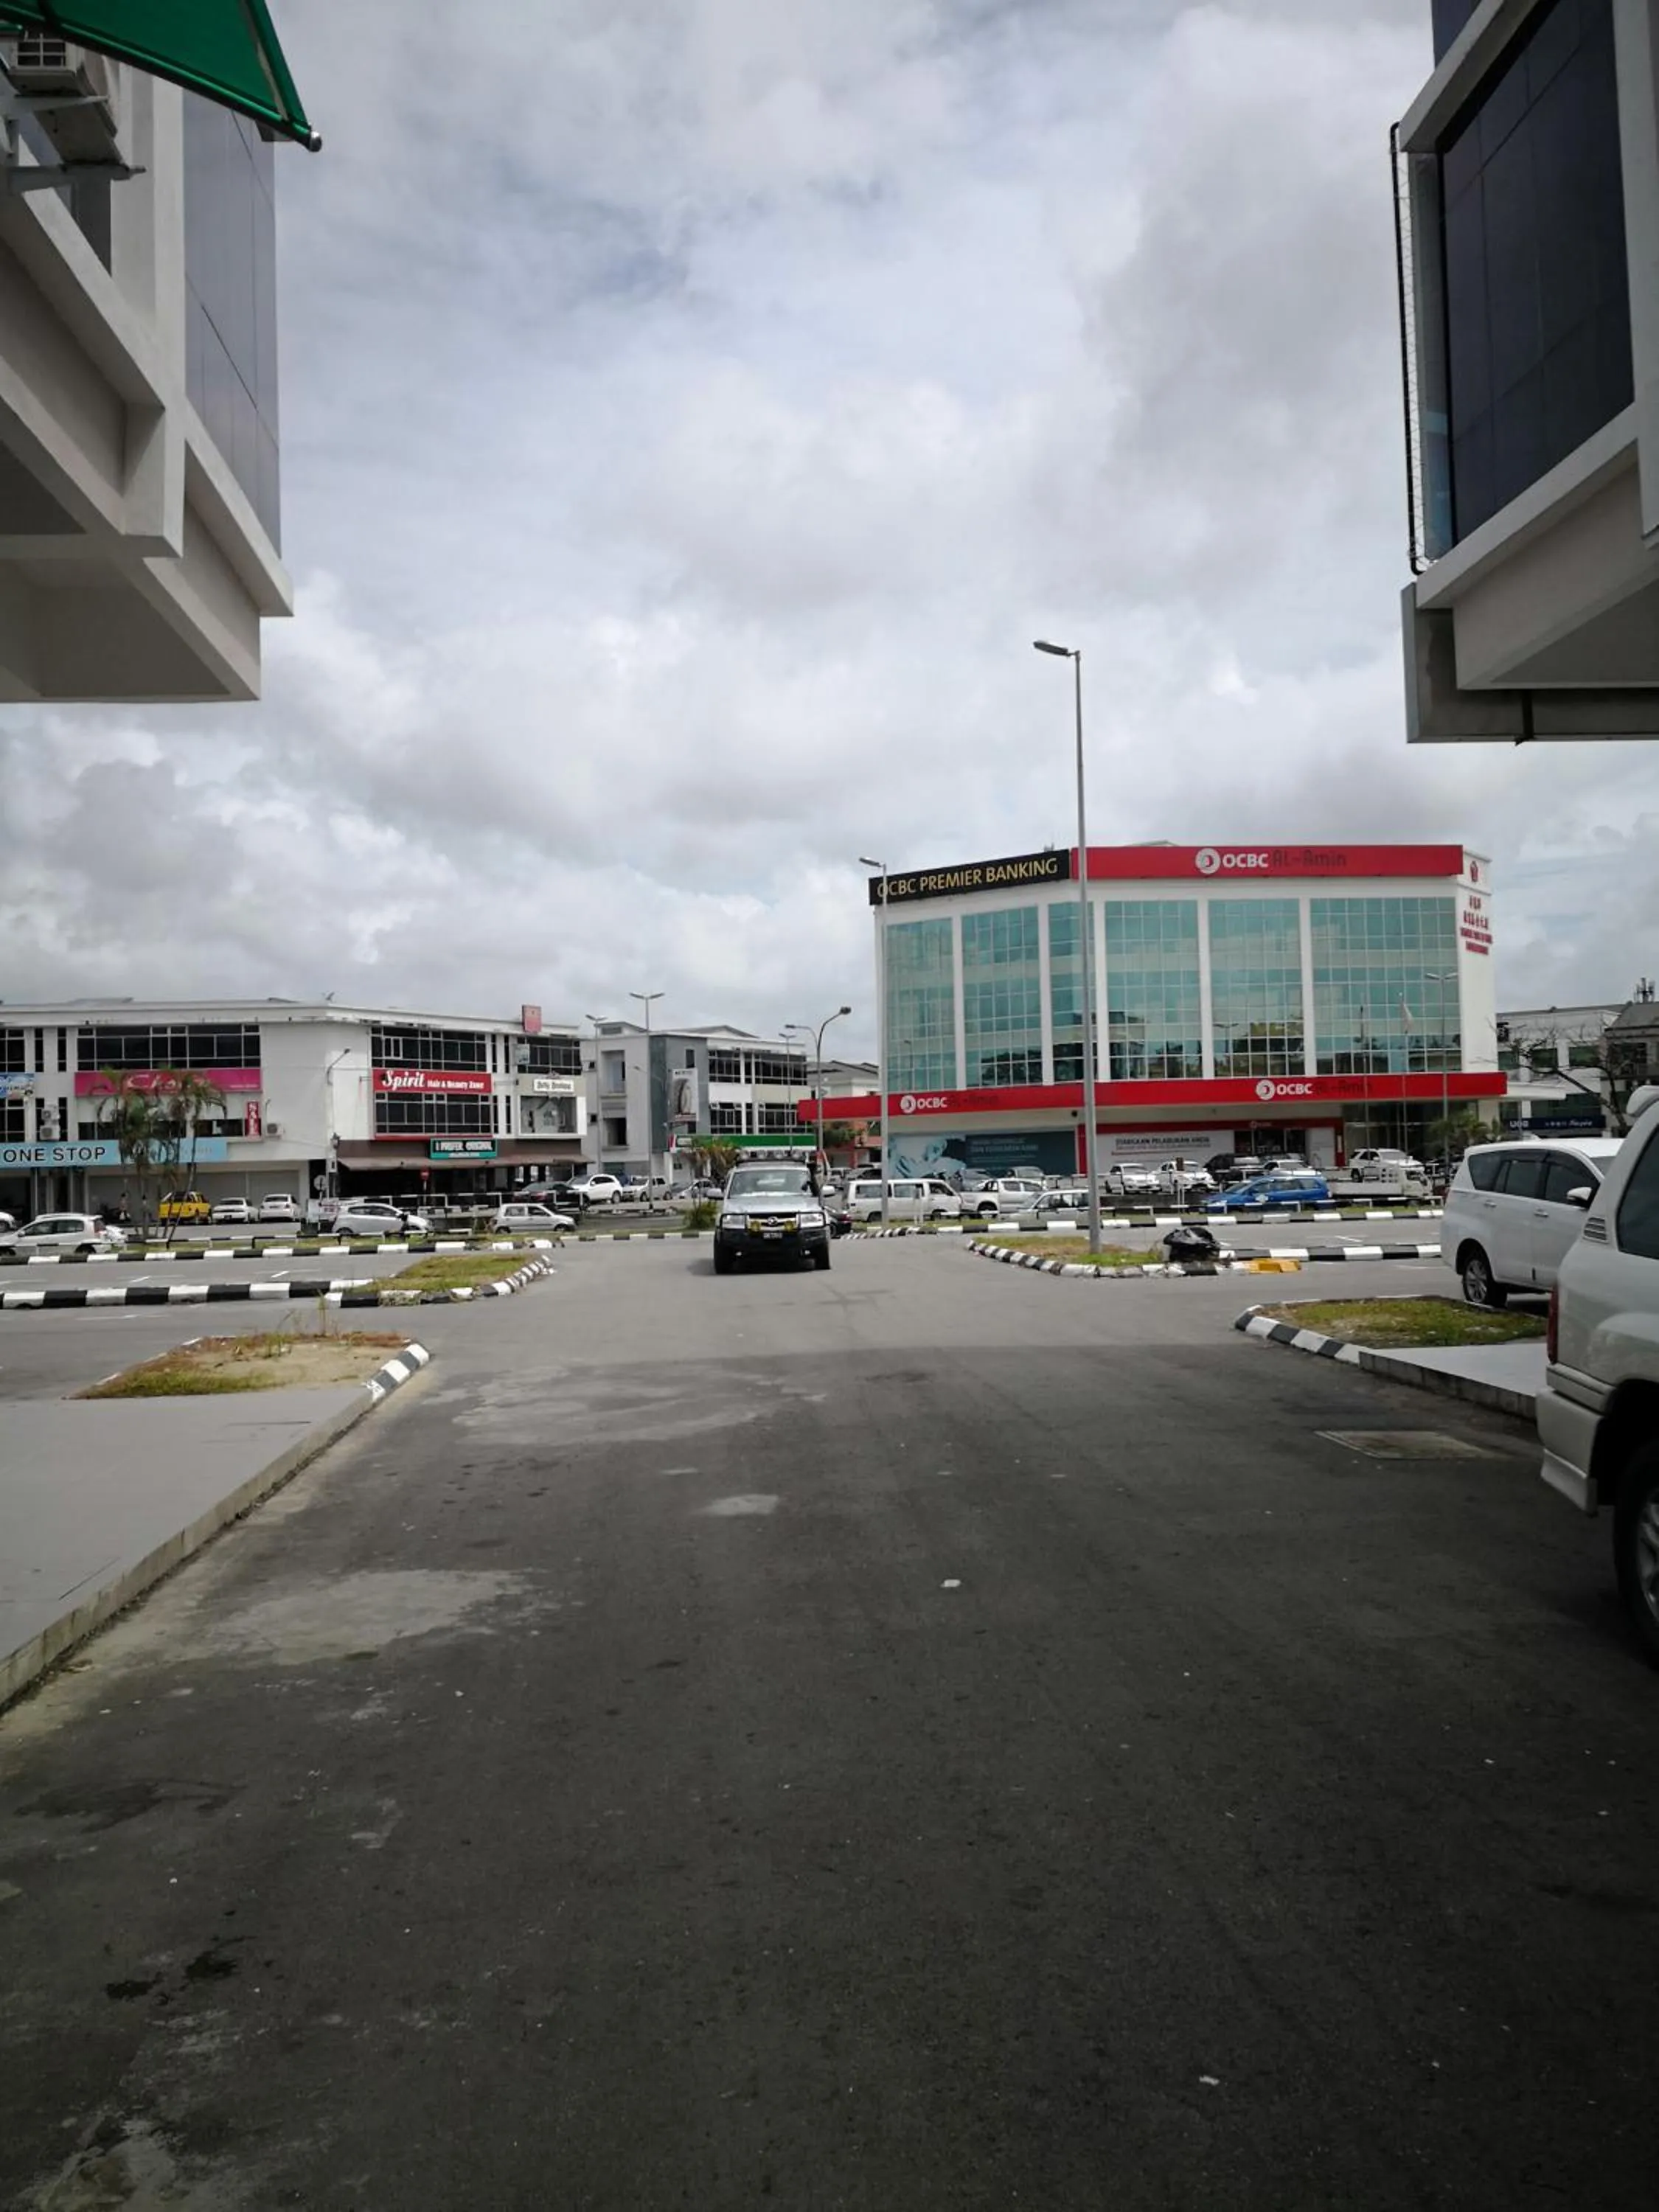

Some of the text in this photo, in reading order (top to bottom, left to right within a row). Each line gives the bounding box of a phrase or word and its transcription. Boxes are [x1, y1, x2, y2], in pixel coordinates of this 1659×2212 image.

[1222, 852, 1269, 869] OCBC
[877, 858, 1058, 897] OCBC PREMIER BANKING
[380, 1070, 425, 1091] Spirit
[1276, 1082, 1313, 1096] OCBC
[917, 1096, 947, 1110] OCBC
[3, 1147, 106, 1163] ONE STOP
